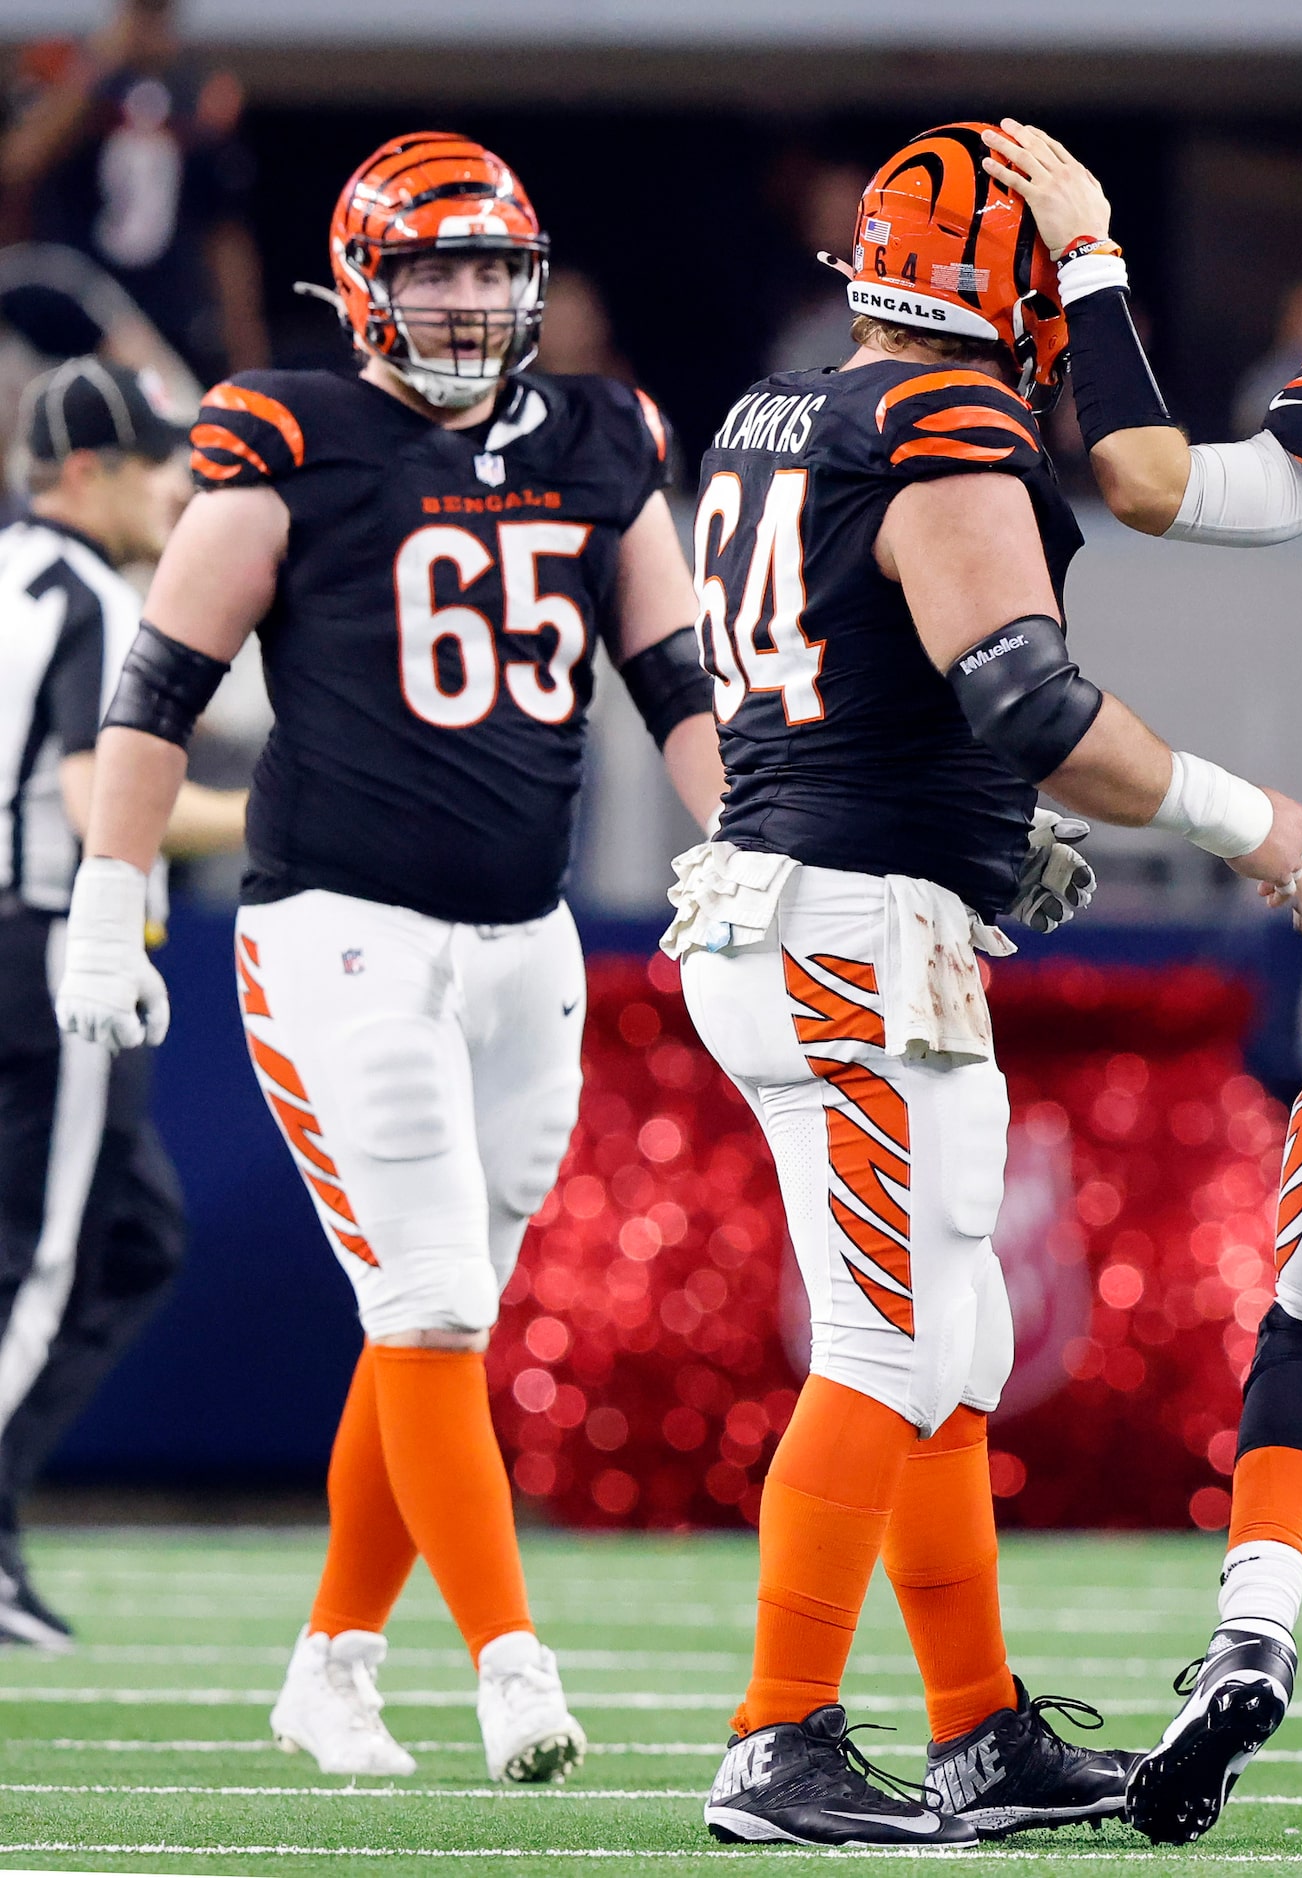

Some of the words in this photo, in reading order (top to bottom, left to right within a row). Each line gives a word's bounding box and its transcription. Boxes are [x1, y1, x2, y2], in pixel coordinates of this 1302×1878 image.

[874, 246, 888, 278] 6
[901, 252, 918, 283] 4
[852, 291, 947, 321] BENGALS
[714, 392, 827, 454] KARRAS
[421, 489, 562, 514] BENGALS
[392, 519, 595, 729] 65
[693, 468, 827, 726] 64
[924, 1730, 1007, 1816] NIKE
